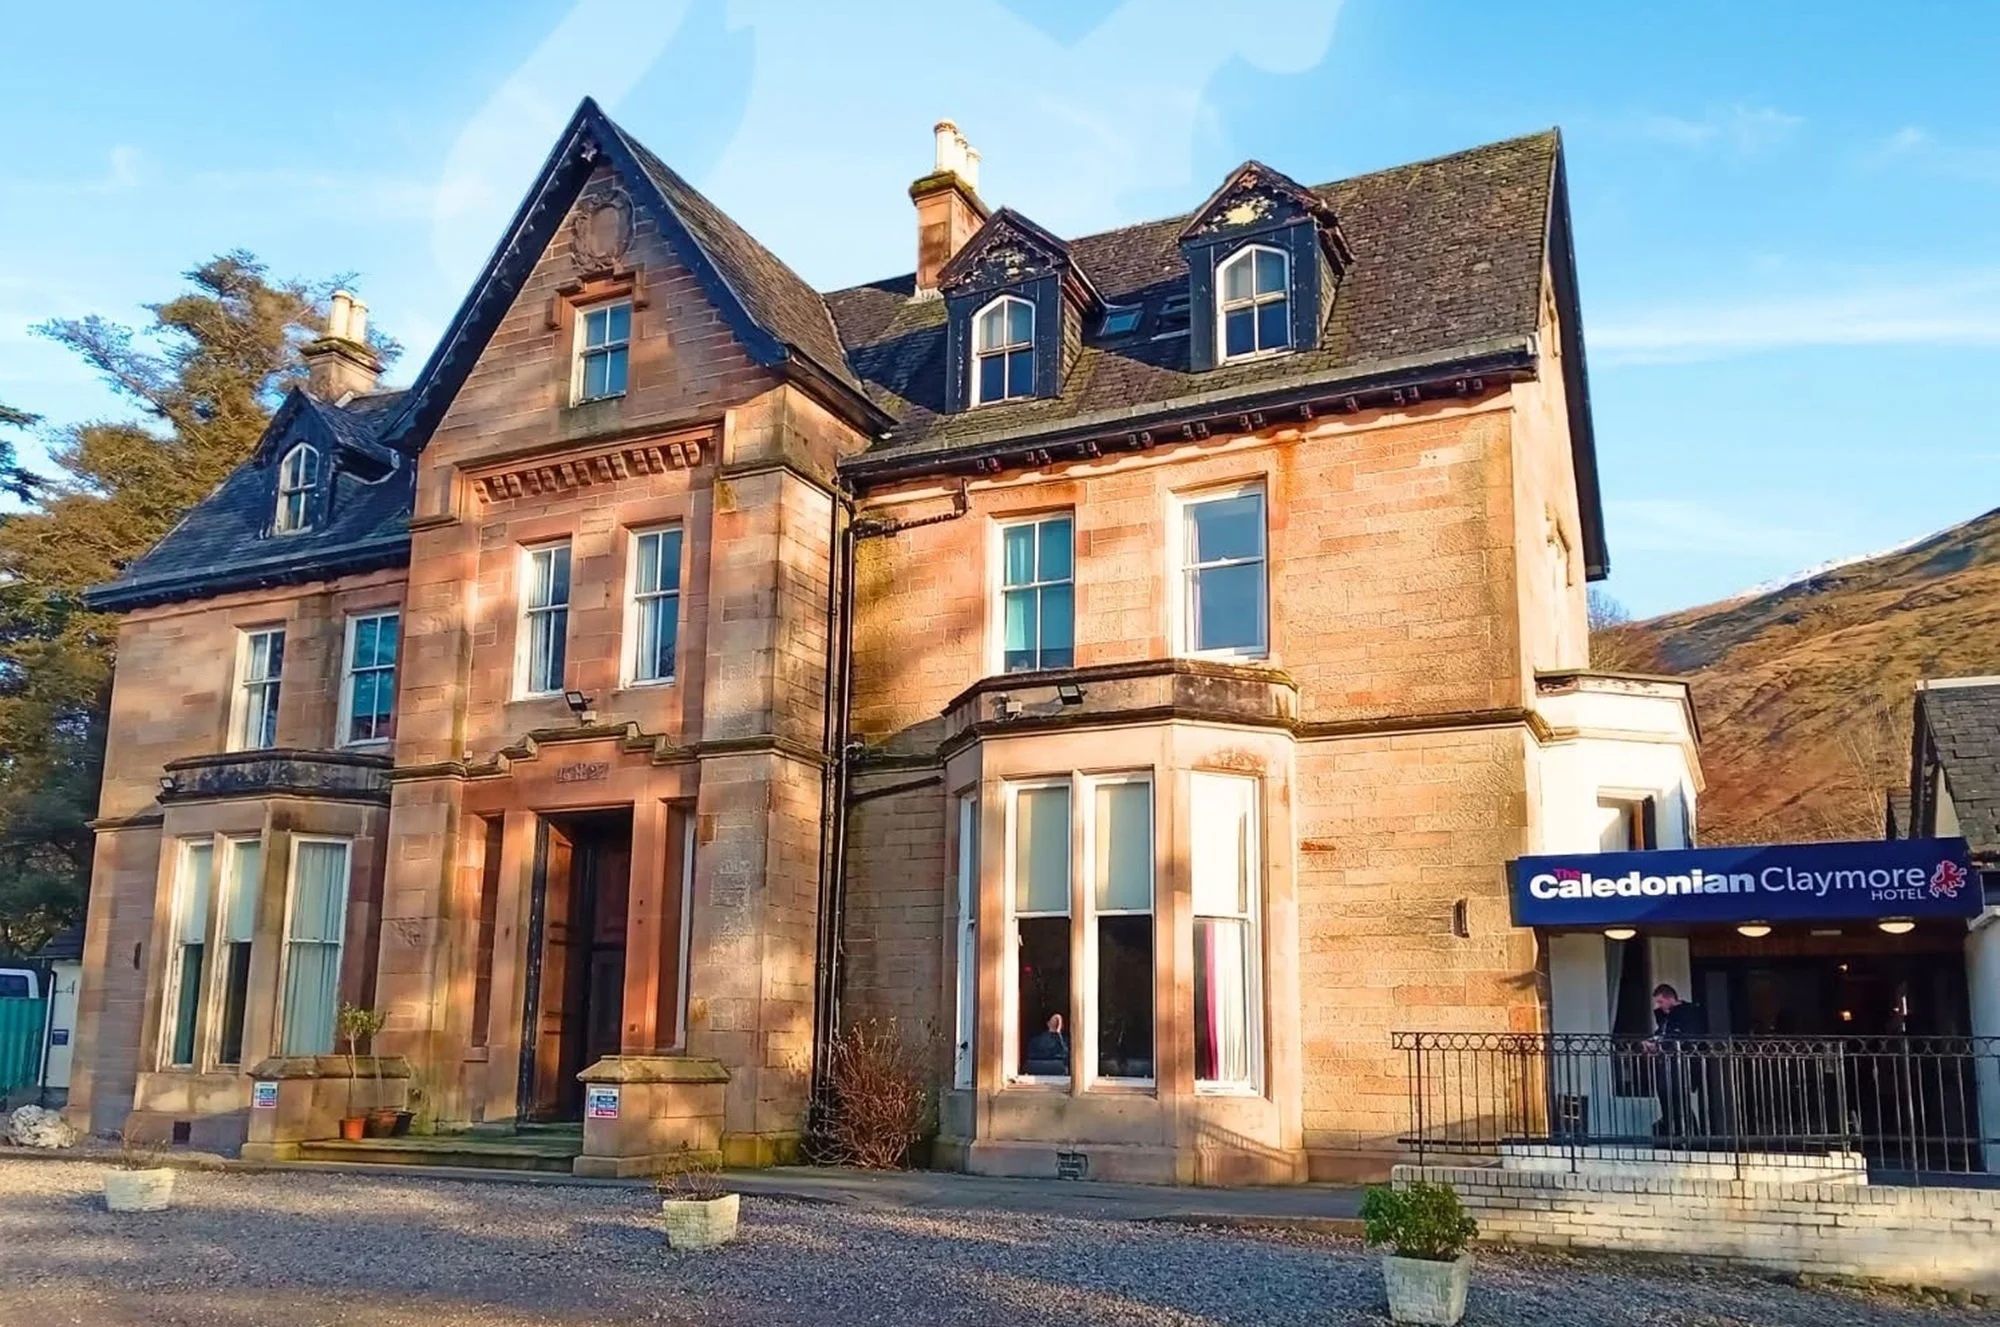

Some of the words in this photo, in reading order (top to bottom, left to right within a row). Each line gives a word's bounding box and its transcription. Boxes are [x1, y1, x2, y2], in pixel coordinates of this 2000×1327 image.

[1553, 868, 1581, 881] The
[1529, 868, 1756, 899] Caledonian
[1760, 866, 1926, 897] Claymore
[1871, 888, 1927, 902] HOTEL
